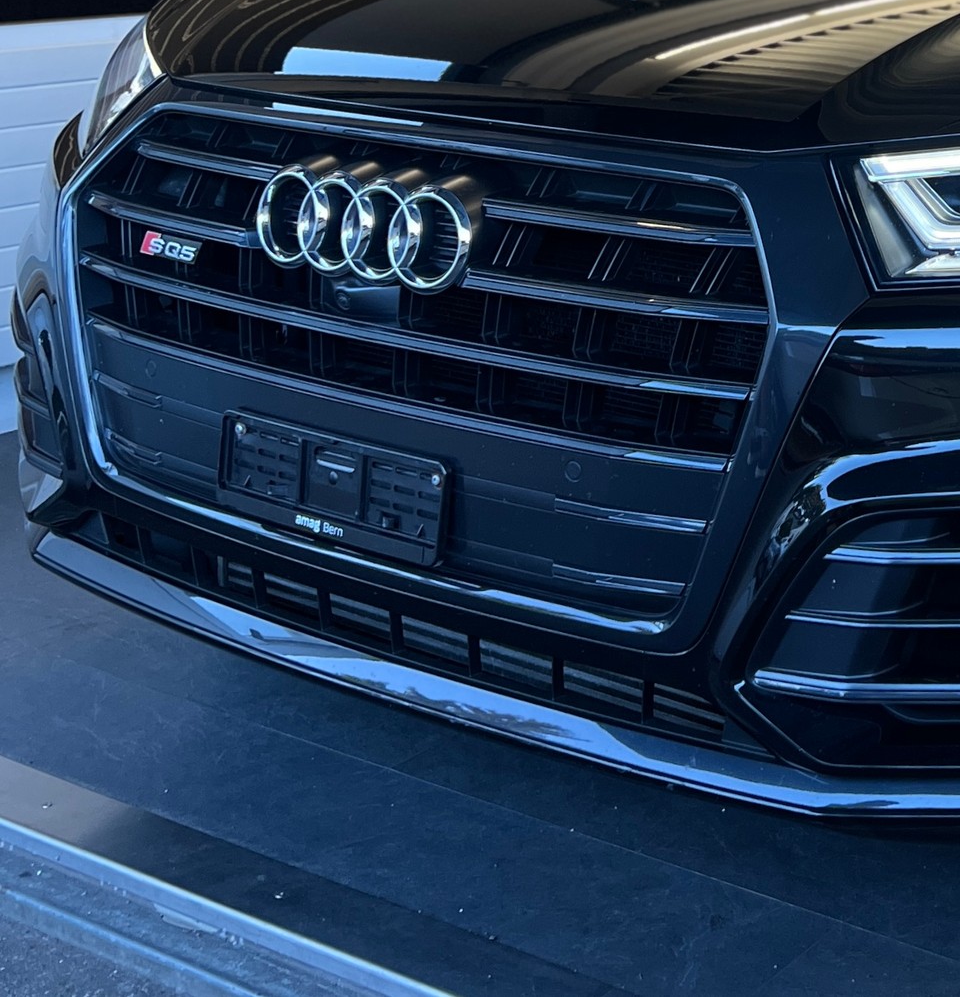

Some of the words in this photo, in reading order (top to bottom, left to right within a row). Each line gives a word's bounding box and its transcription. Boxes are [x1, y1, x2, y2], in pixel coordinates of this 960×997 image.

[148, 237, 197, 262] SQ5
[295, 514, 321, 533] amag
[322, 521, 344, 537] Bern
